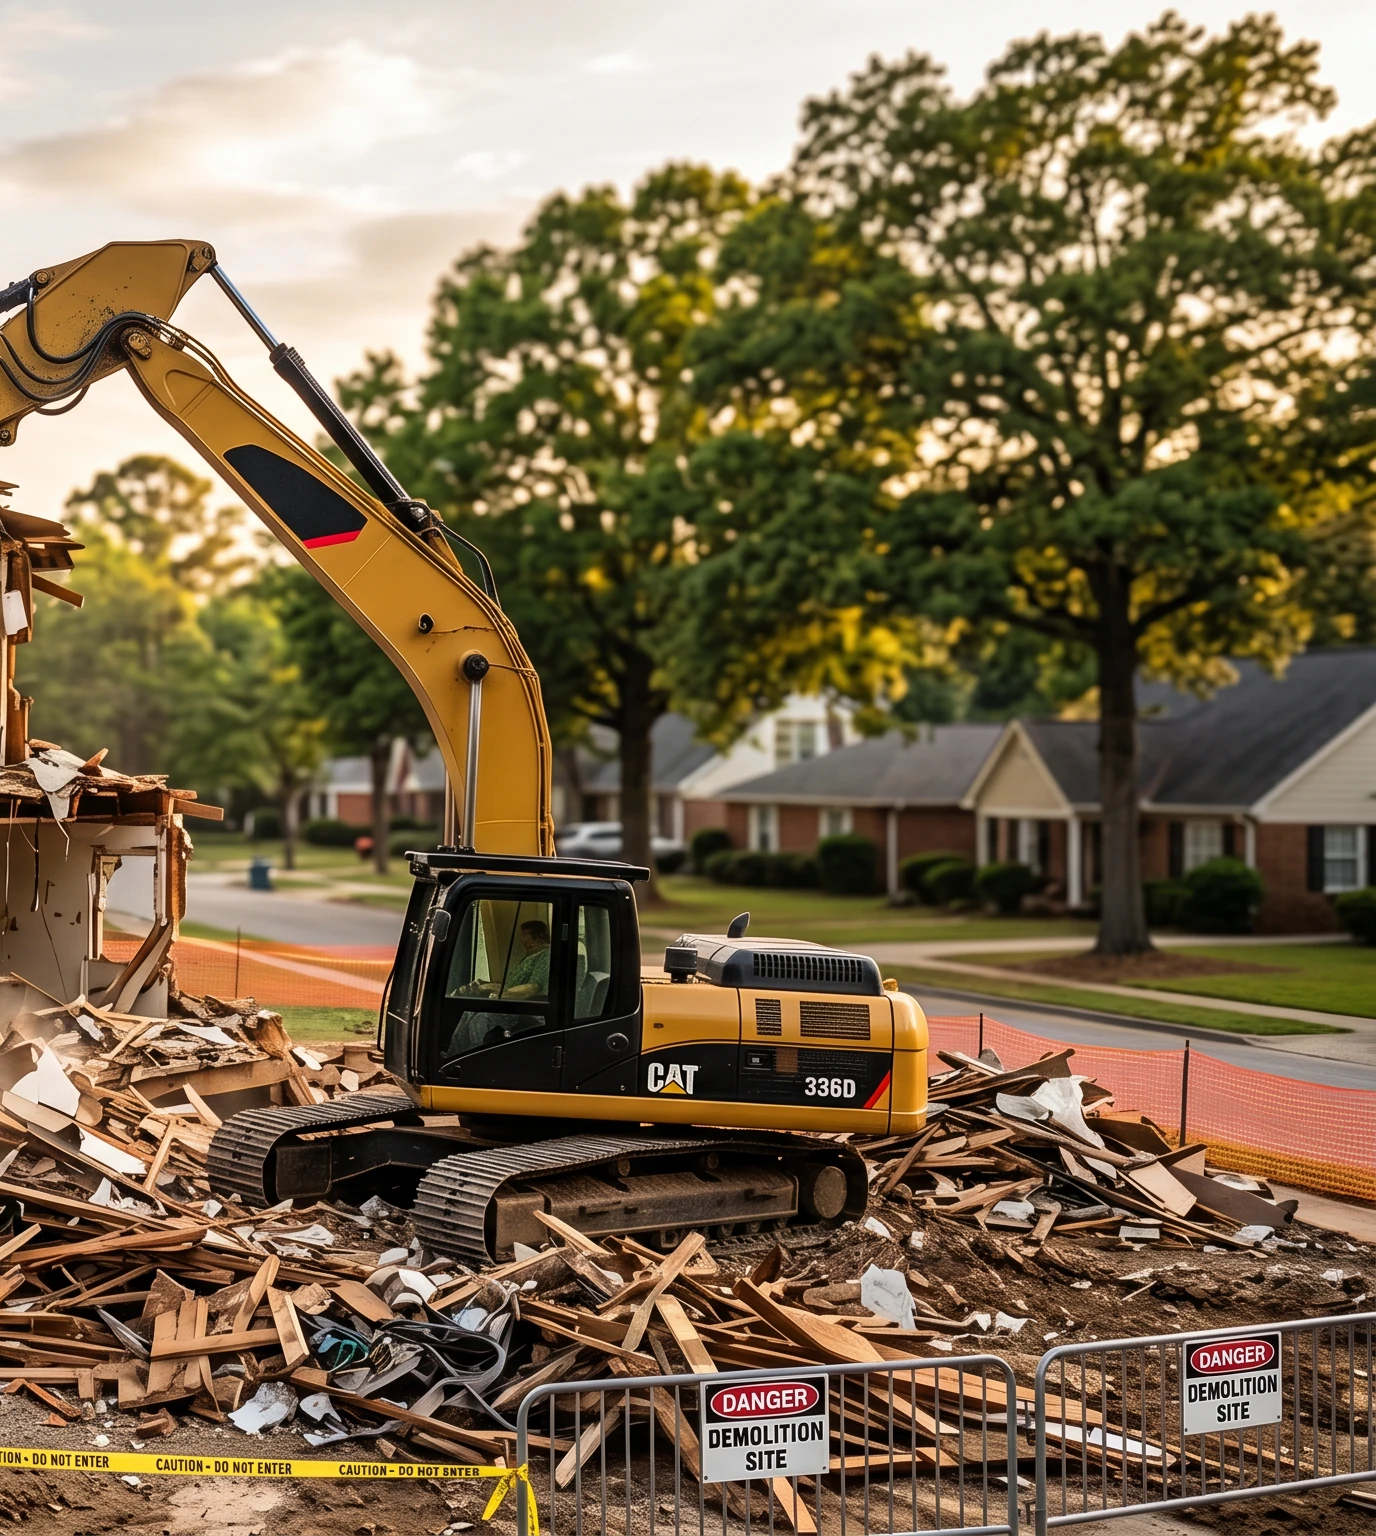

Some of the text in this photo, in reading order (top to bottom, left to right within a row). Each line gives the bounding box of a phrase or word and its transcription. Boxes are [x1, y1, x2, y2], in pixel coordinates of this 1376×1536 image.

[647, 1062, 699, 1095] CAT
[804, 1076, 856, 1098] 336D
[1199, 1345, 1266, 1369] DANGER
[1188, 1374, 1278, 1403] DEMOLITION
[722, 1388, 808, 1413] DANGER
[1216, 1401, 1250, 1423] SITE
[708, 1420, 824, 1449] DEMOLITION
[32, 1452, 47, 1466] DO
[50, 1453, 72, 1467] NOT
[74, 1454, 110, 1469] ENTER
[155, 1458, 203, 1472] CAUTION
[214, 1460, 229, 1473] DO
[232, 1461, 255, 1474] NOT
[257, 1462, 292, 1474] ENTER
[338, 1464, 387, 1475] CAUTION
[398, 1466, 414, 1476] DO
[745, 1449, 787, 1472] SITE
